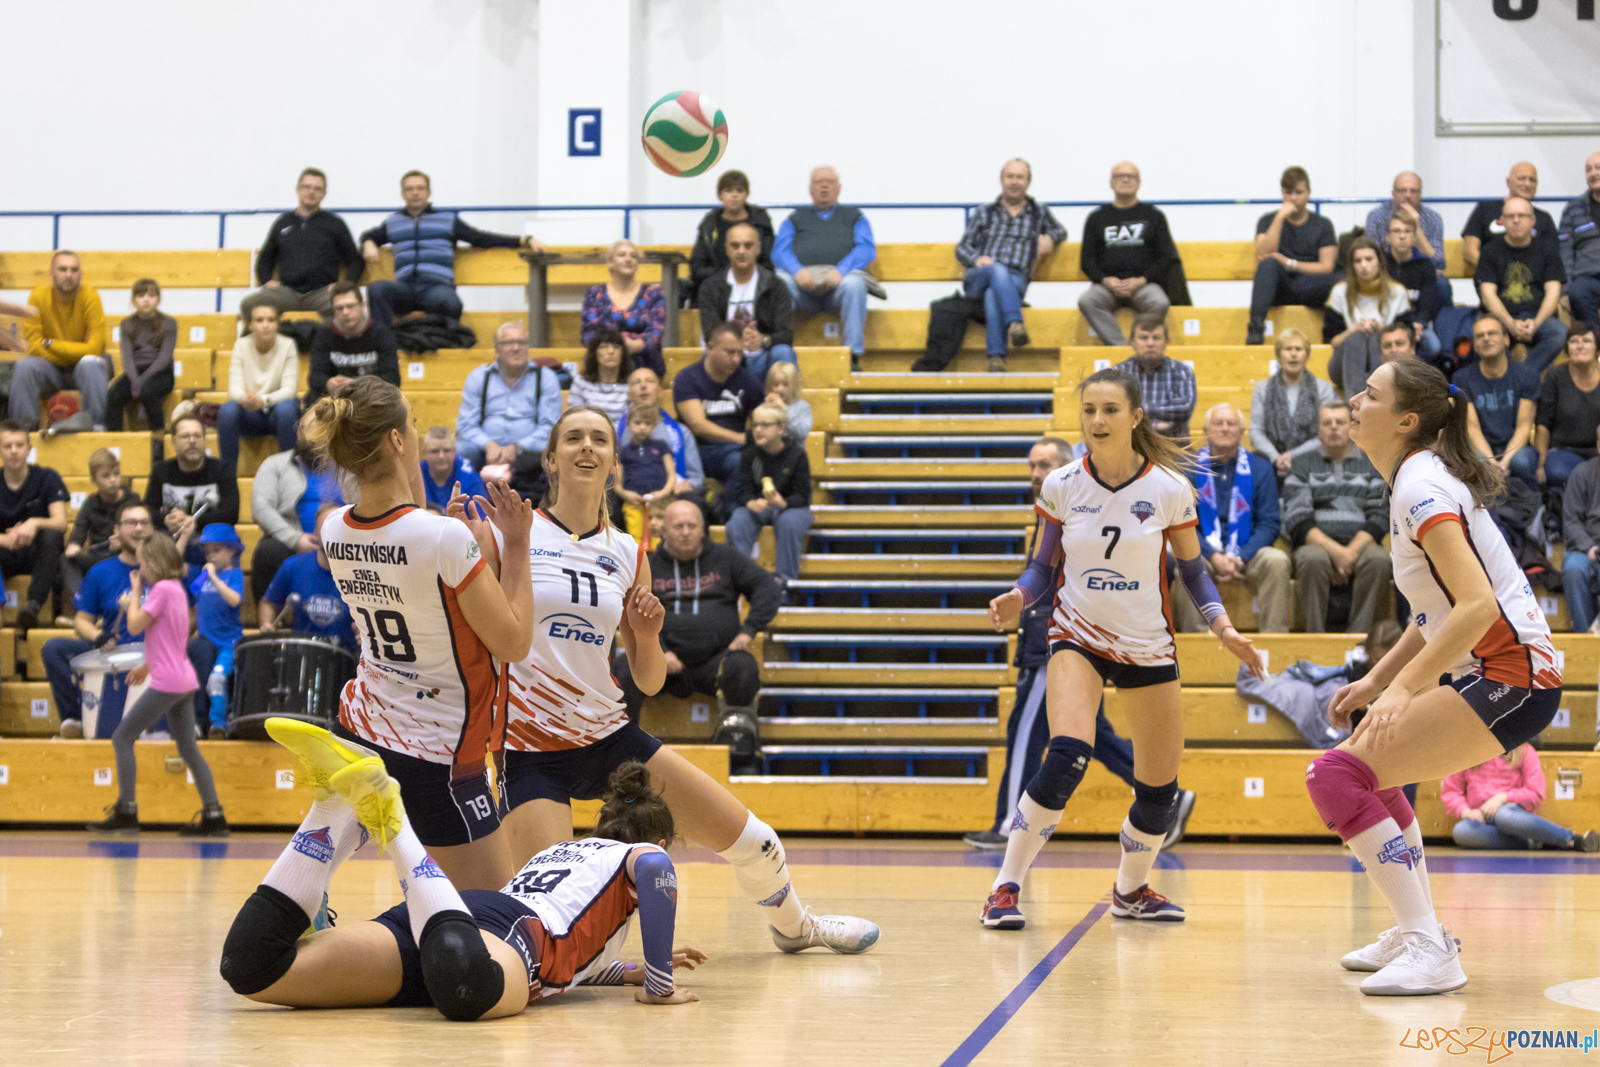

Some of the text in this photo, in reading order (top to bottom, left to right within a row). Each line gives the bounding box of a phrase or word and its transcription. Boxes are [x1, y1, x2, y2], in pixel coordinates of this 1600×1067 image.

[575, 115, 596, 149] C
[1104, 223, 1144, 241] EA7
[1072, 505, 1102, 514] OZnan
[1409, 497, 1435, 516] Enea
[326, 541, 408, 565] MUSZYŃSKA
[530, 549, 563, 558] OZnan
[1101, 525, 1121, 560] 7
[352, 569, 381, 583] ENEA
[562, 568, 598, 607] 11
[1086, 576, 1140, 591] Enea
[338, 579, 405, 605] ENERGETYK
[356, 606, 417, 662] 19
[548, 621, 605, 646] Enea
[465, 795, 491, 821] 19
